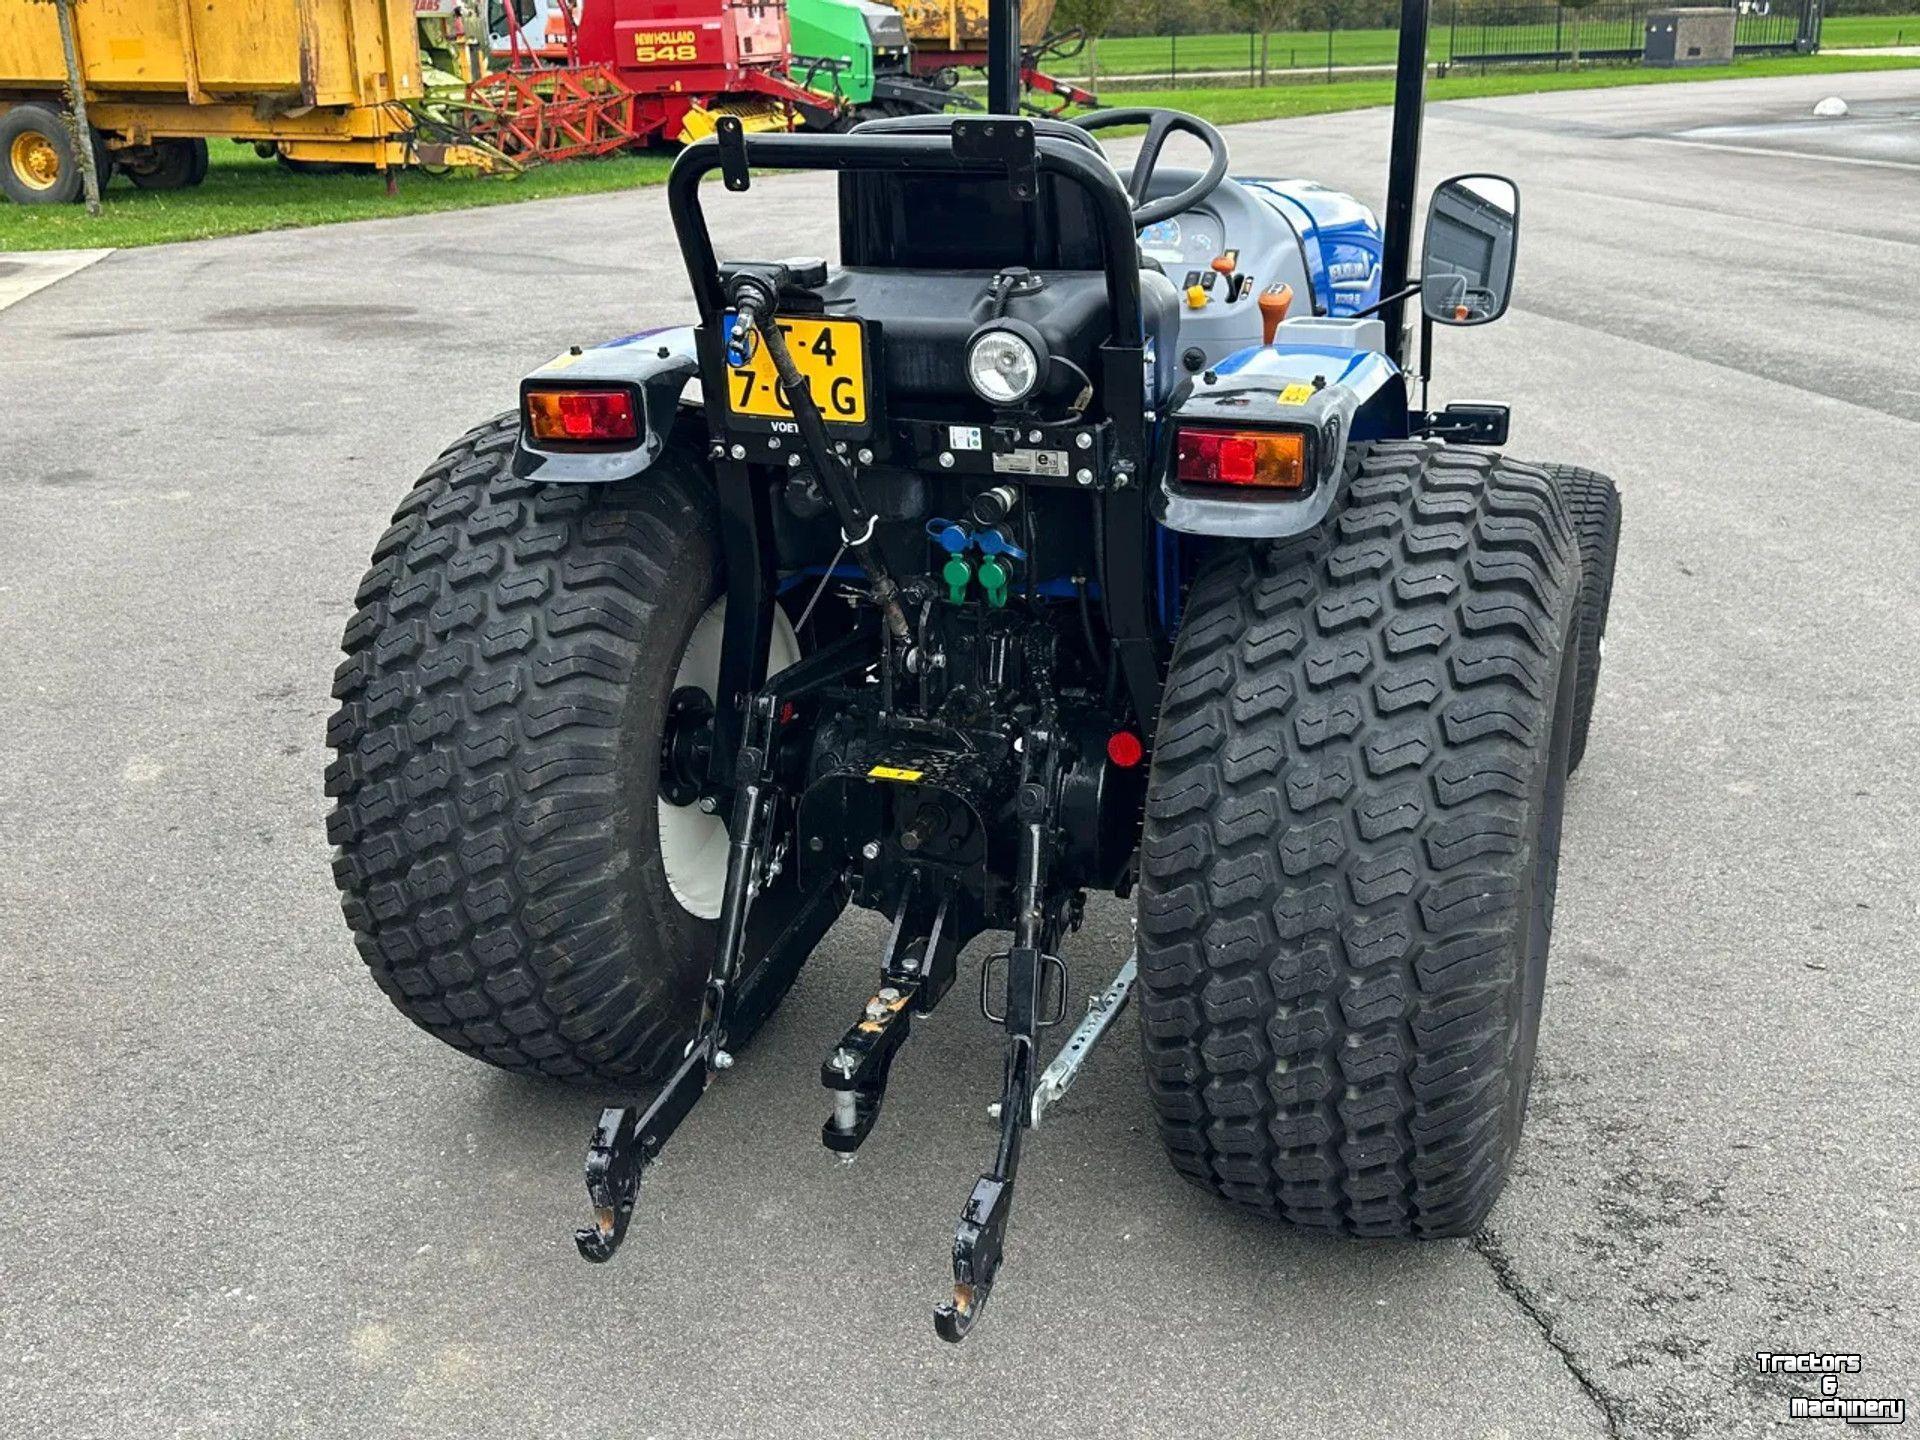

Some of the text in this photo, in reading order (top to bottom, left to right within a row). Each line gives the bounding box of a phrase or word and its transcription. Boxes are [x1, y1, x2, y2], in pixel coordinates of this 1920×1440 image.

[635, 30, 696, 46] NEW HOLLAND
[636, 45, 697, 62] 548
